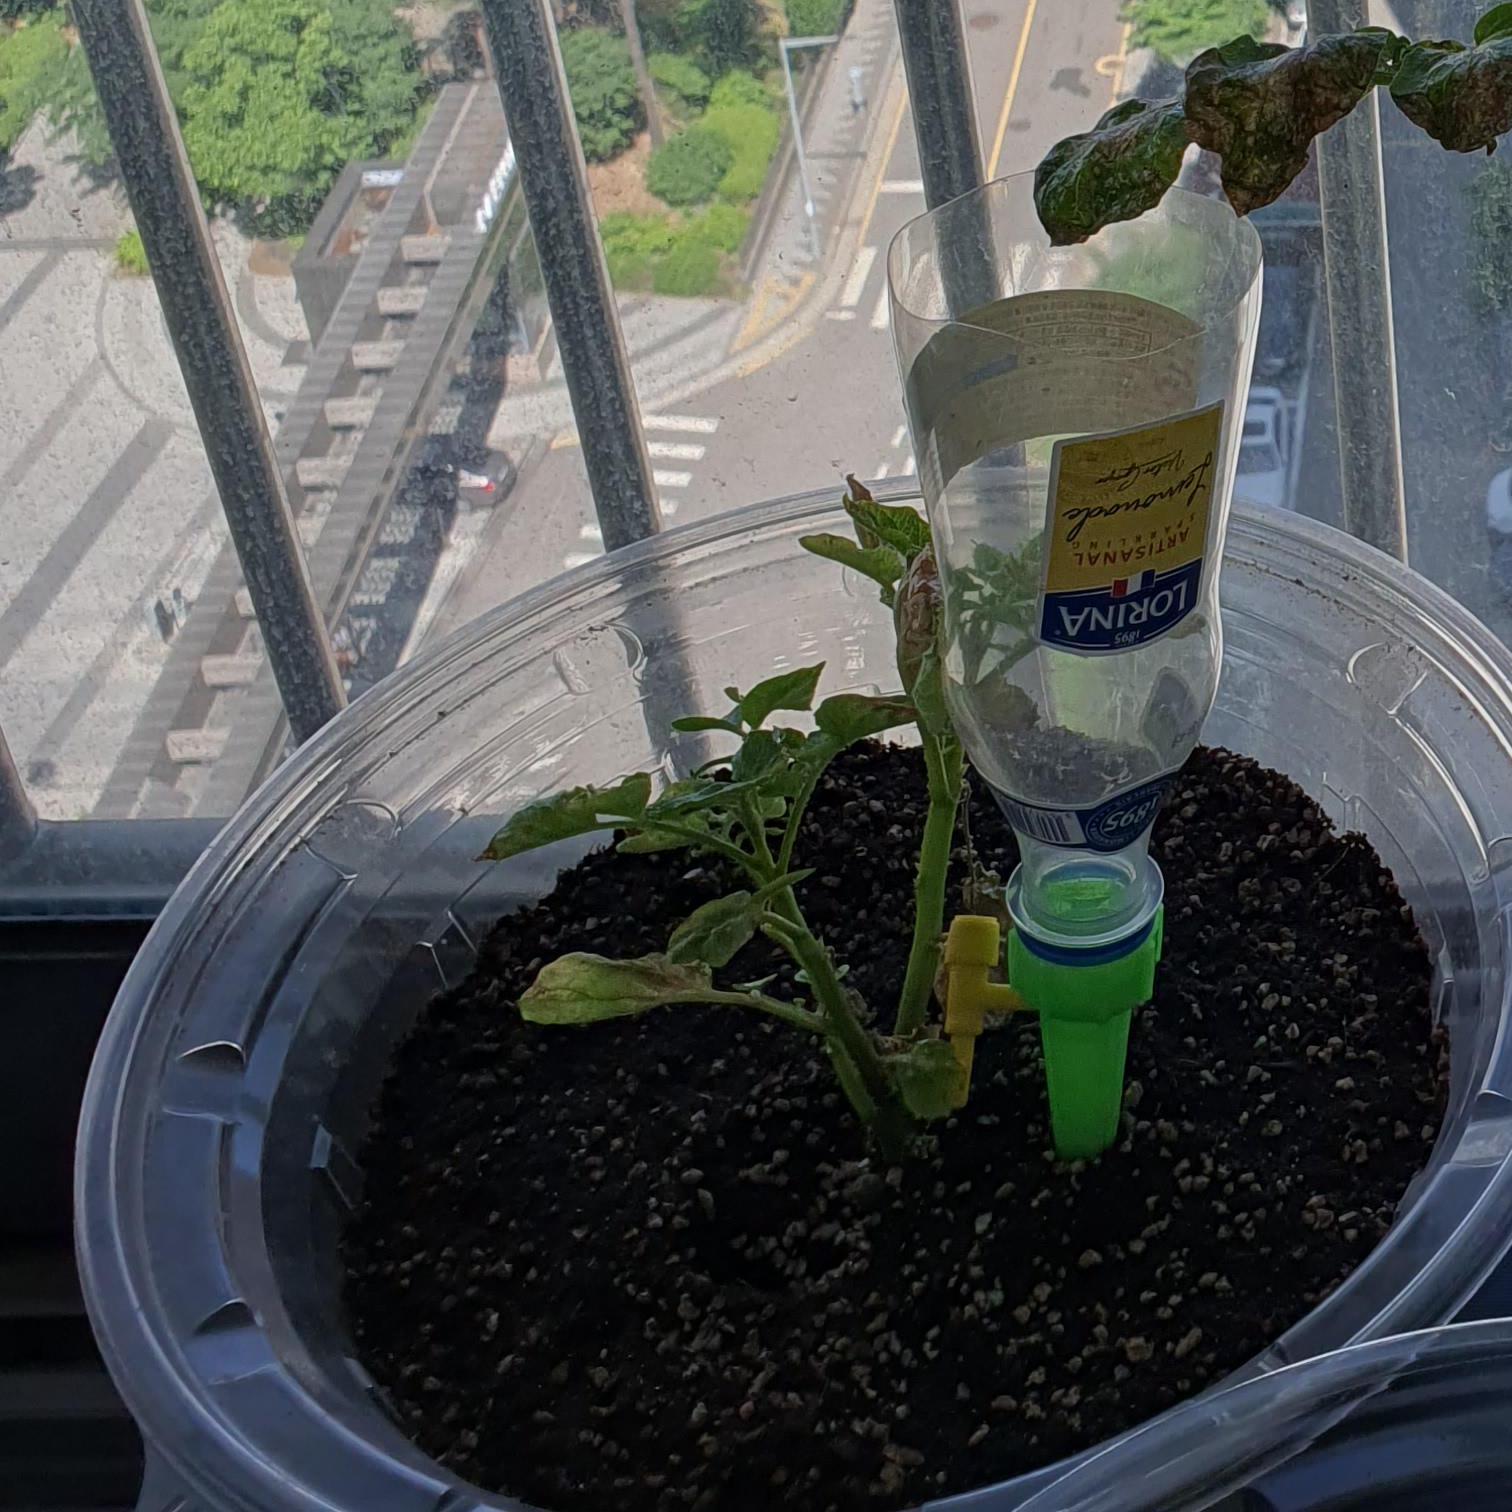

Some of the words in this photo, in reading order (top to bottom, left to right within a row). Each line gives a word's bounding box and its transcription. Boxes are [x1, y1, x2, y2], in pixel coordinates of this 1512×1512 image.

[1073, 527, 1190, 566] ARTISANAL
[1057, 579, 1188, 636] LORINA
[1113, 628, 1140, 644] 1895
[1104, 795, 1158, 832] 1895
